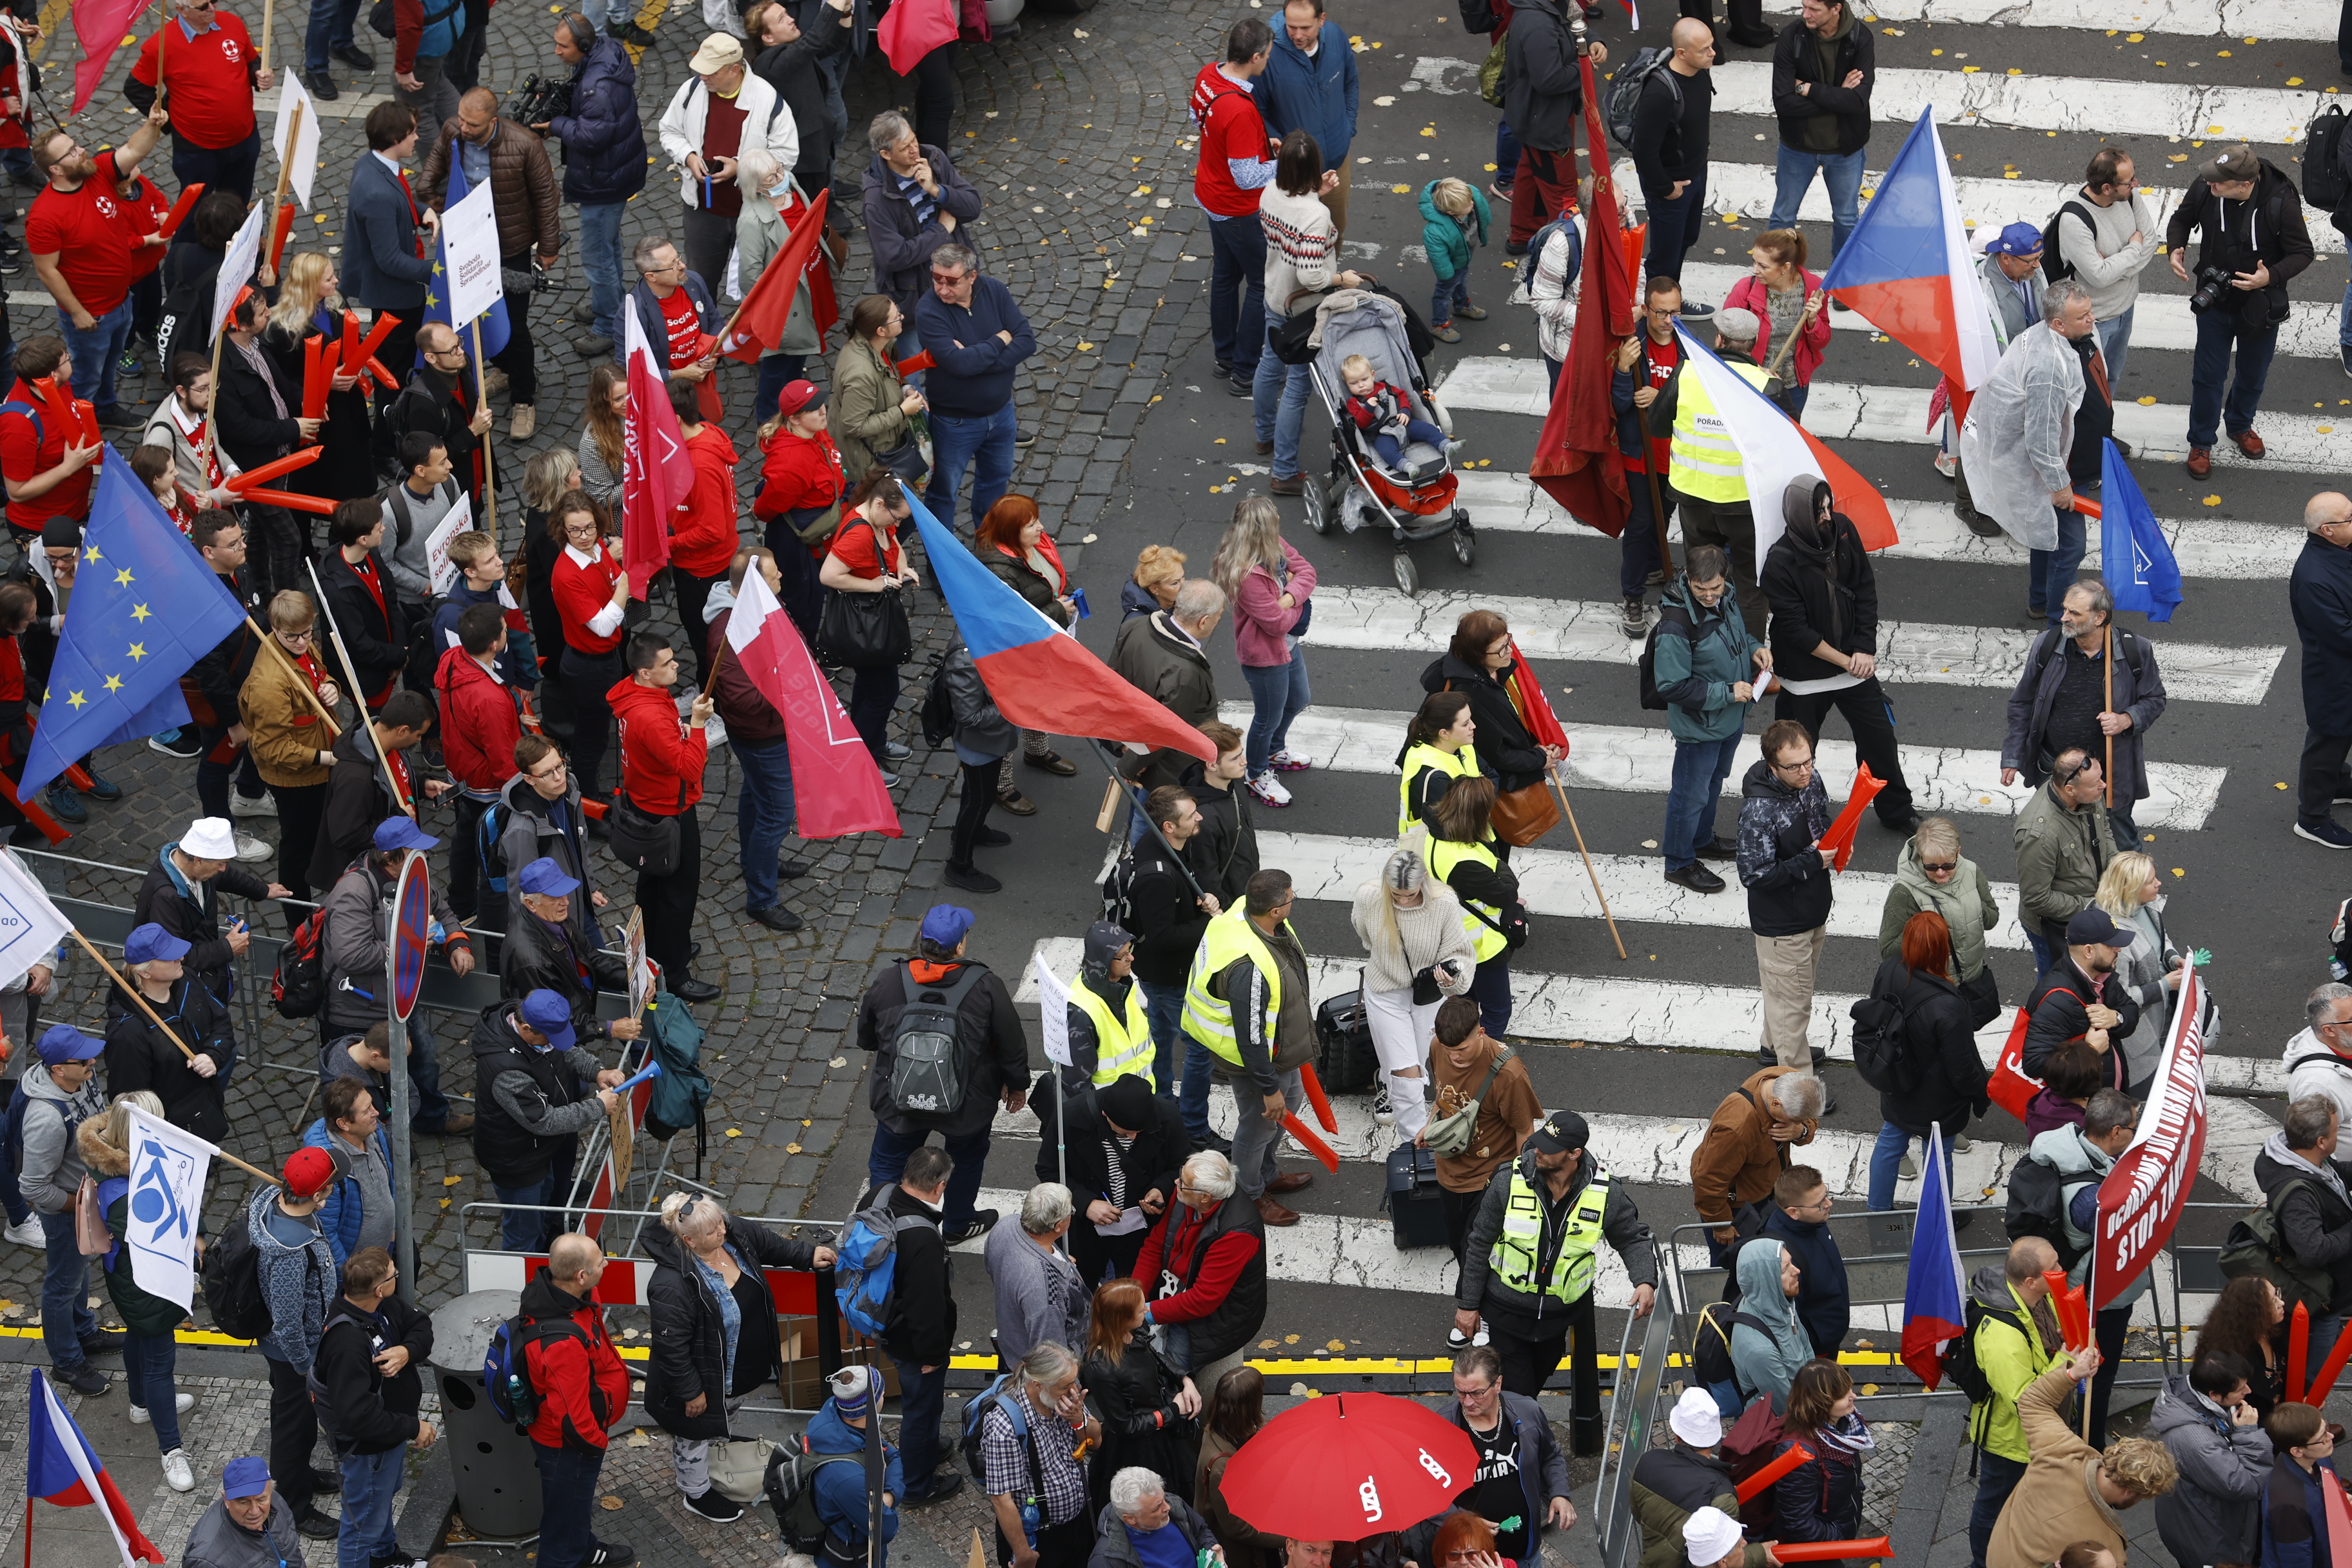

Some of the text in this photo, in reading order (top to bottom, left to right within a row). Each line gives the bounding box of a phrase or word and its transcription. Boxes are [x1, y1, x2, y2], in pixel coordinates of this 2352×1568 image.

[458, 253, 481, 273] Svoboda
[459, 260, 484, 280] Solidarita
[460, 259, 492, 288] Spravedlnost
[156, 314, 177, 373] adidas
[432, 510, 469, 563] Evropská
[1580, 1210, 1599, 1220] SECURITY
[2106, 1154, 2166, 1239] OCHRAŇME
[2116, 1200, 2158, 1271] STOP
